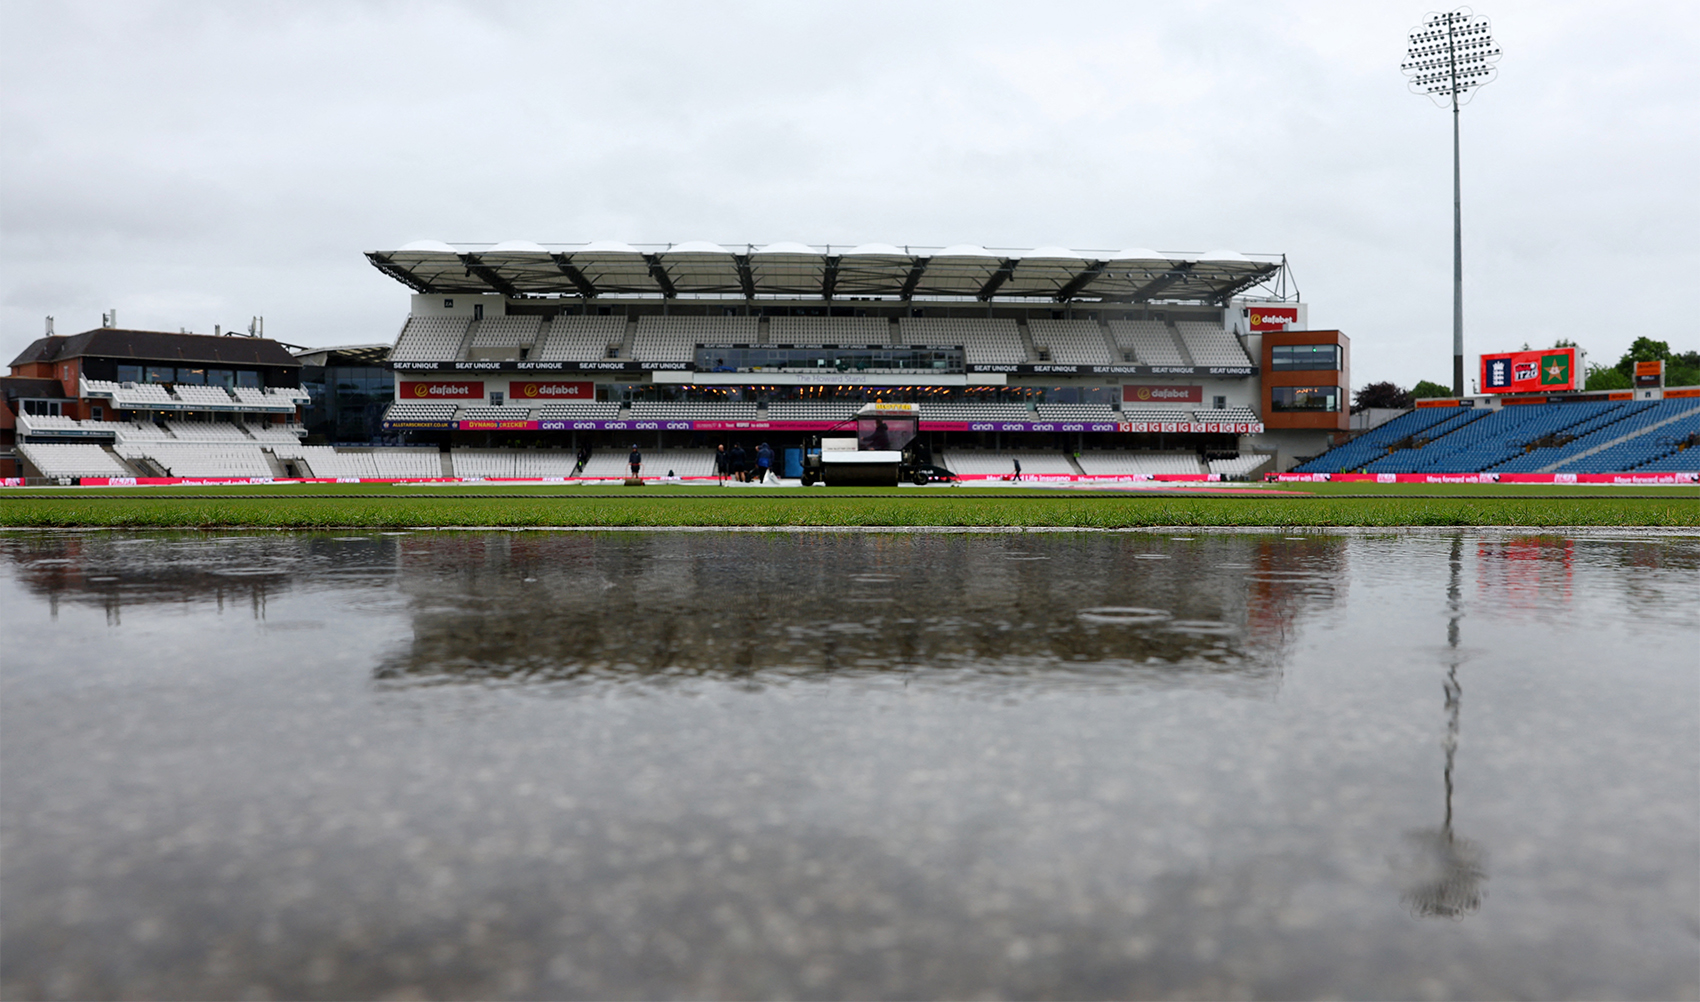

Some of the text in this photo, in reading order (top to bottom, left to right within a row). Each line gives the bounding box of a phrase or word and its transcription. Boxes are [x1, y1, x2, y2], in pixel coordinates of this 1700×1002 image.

[1262, 315, 1293, 325] dafabet
[429, 385, 469, 396] dafabet
[539, 385, 579, 396] dafabet
[1151, 389, 1189, 399] dafabet
[542, 421, 564, 429] cinch
[574, 421, 596, 429] cinch
[604, 421, 627, 429] cinch
[636, 421, 658, 429] cinch
[667, 421, 690, 429] cinch
[972, 422, 994, 431] cinch
[1002, 422, 1024, 431] cinch
[1032, 422, 1054, 431] cinch
[1062, 422, 1084, 431] cinch
[1092, 422, 1114, 431] cinch
[1120, 424, 1131, 432] IG
[1134, 424, 1145, 432] IG
[1149, 424, 1160, 432] IG
[1164, 424, 1174, 432] IG
[1178, 424, 1190, 432] IG
[1194, 424, 1204, 432] IG
[1208, 424, 1219, 432] IG
[1222, 424, 1232, 432] IG
[1236, 424, 1248, 432] IG
[1251, 424, 1262, 432] IG
